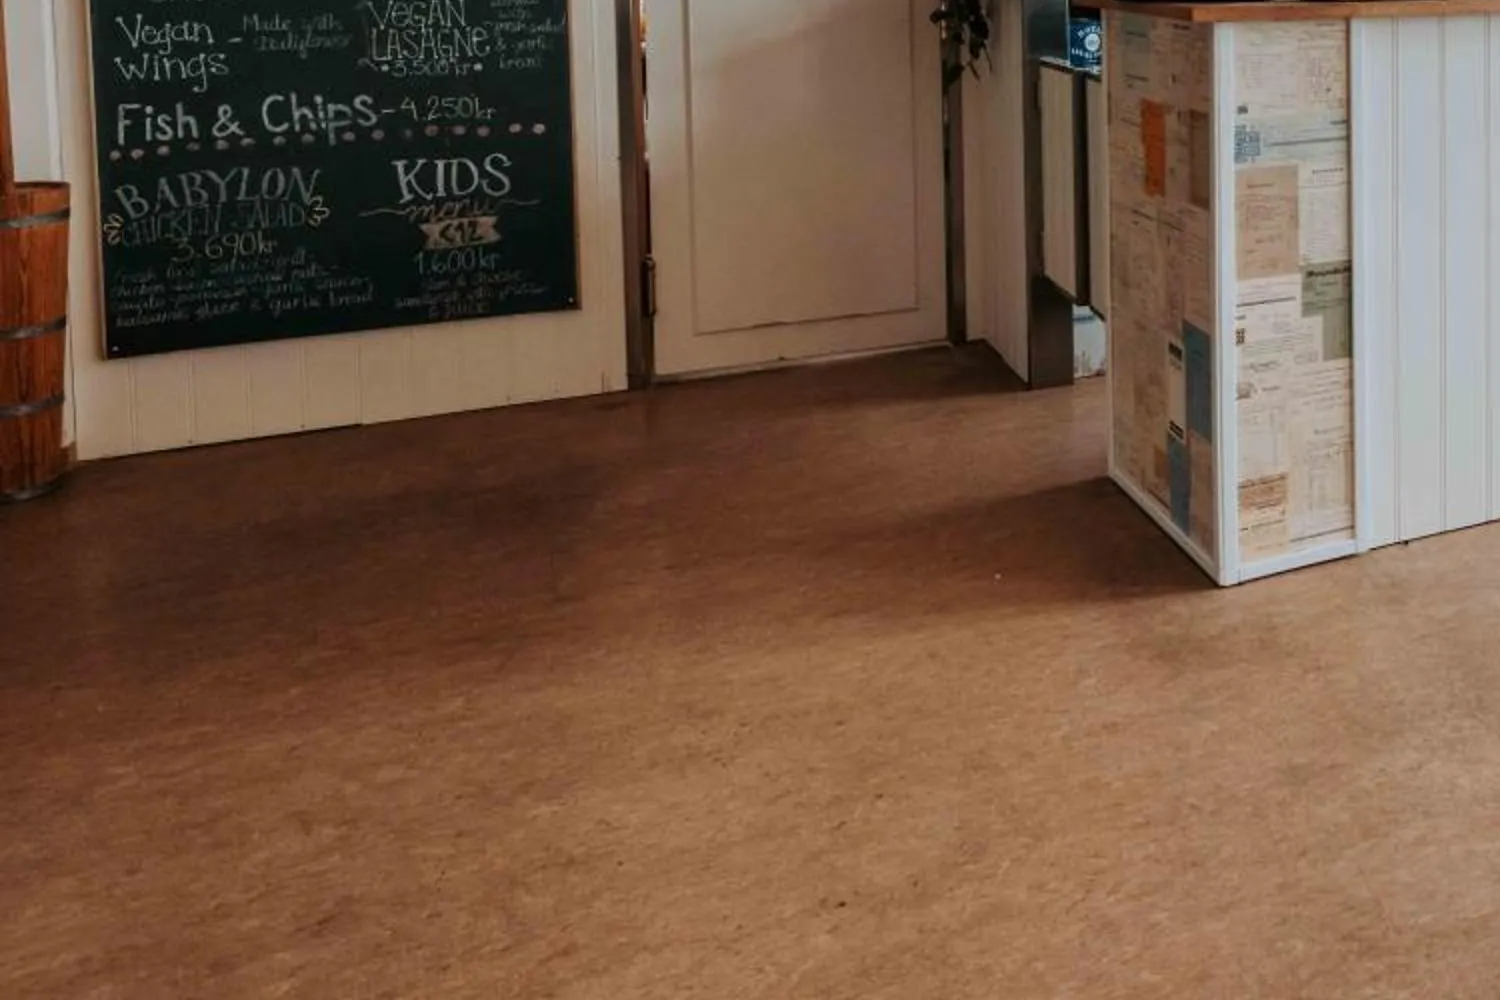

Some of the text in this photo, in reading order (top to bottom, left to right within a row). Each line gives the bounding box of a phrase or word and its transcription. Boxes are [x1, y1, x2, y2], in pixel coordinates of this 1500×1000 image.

[114, 12, 216, 56] Vegan
[113, 51, 230, 94] wings
[116, 100, 201, 147] Fish
[211, 103, 246, 139] &
[114, 165, 322, 221] BABYLON
[390, 152, 514, 205] KIDS
